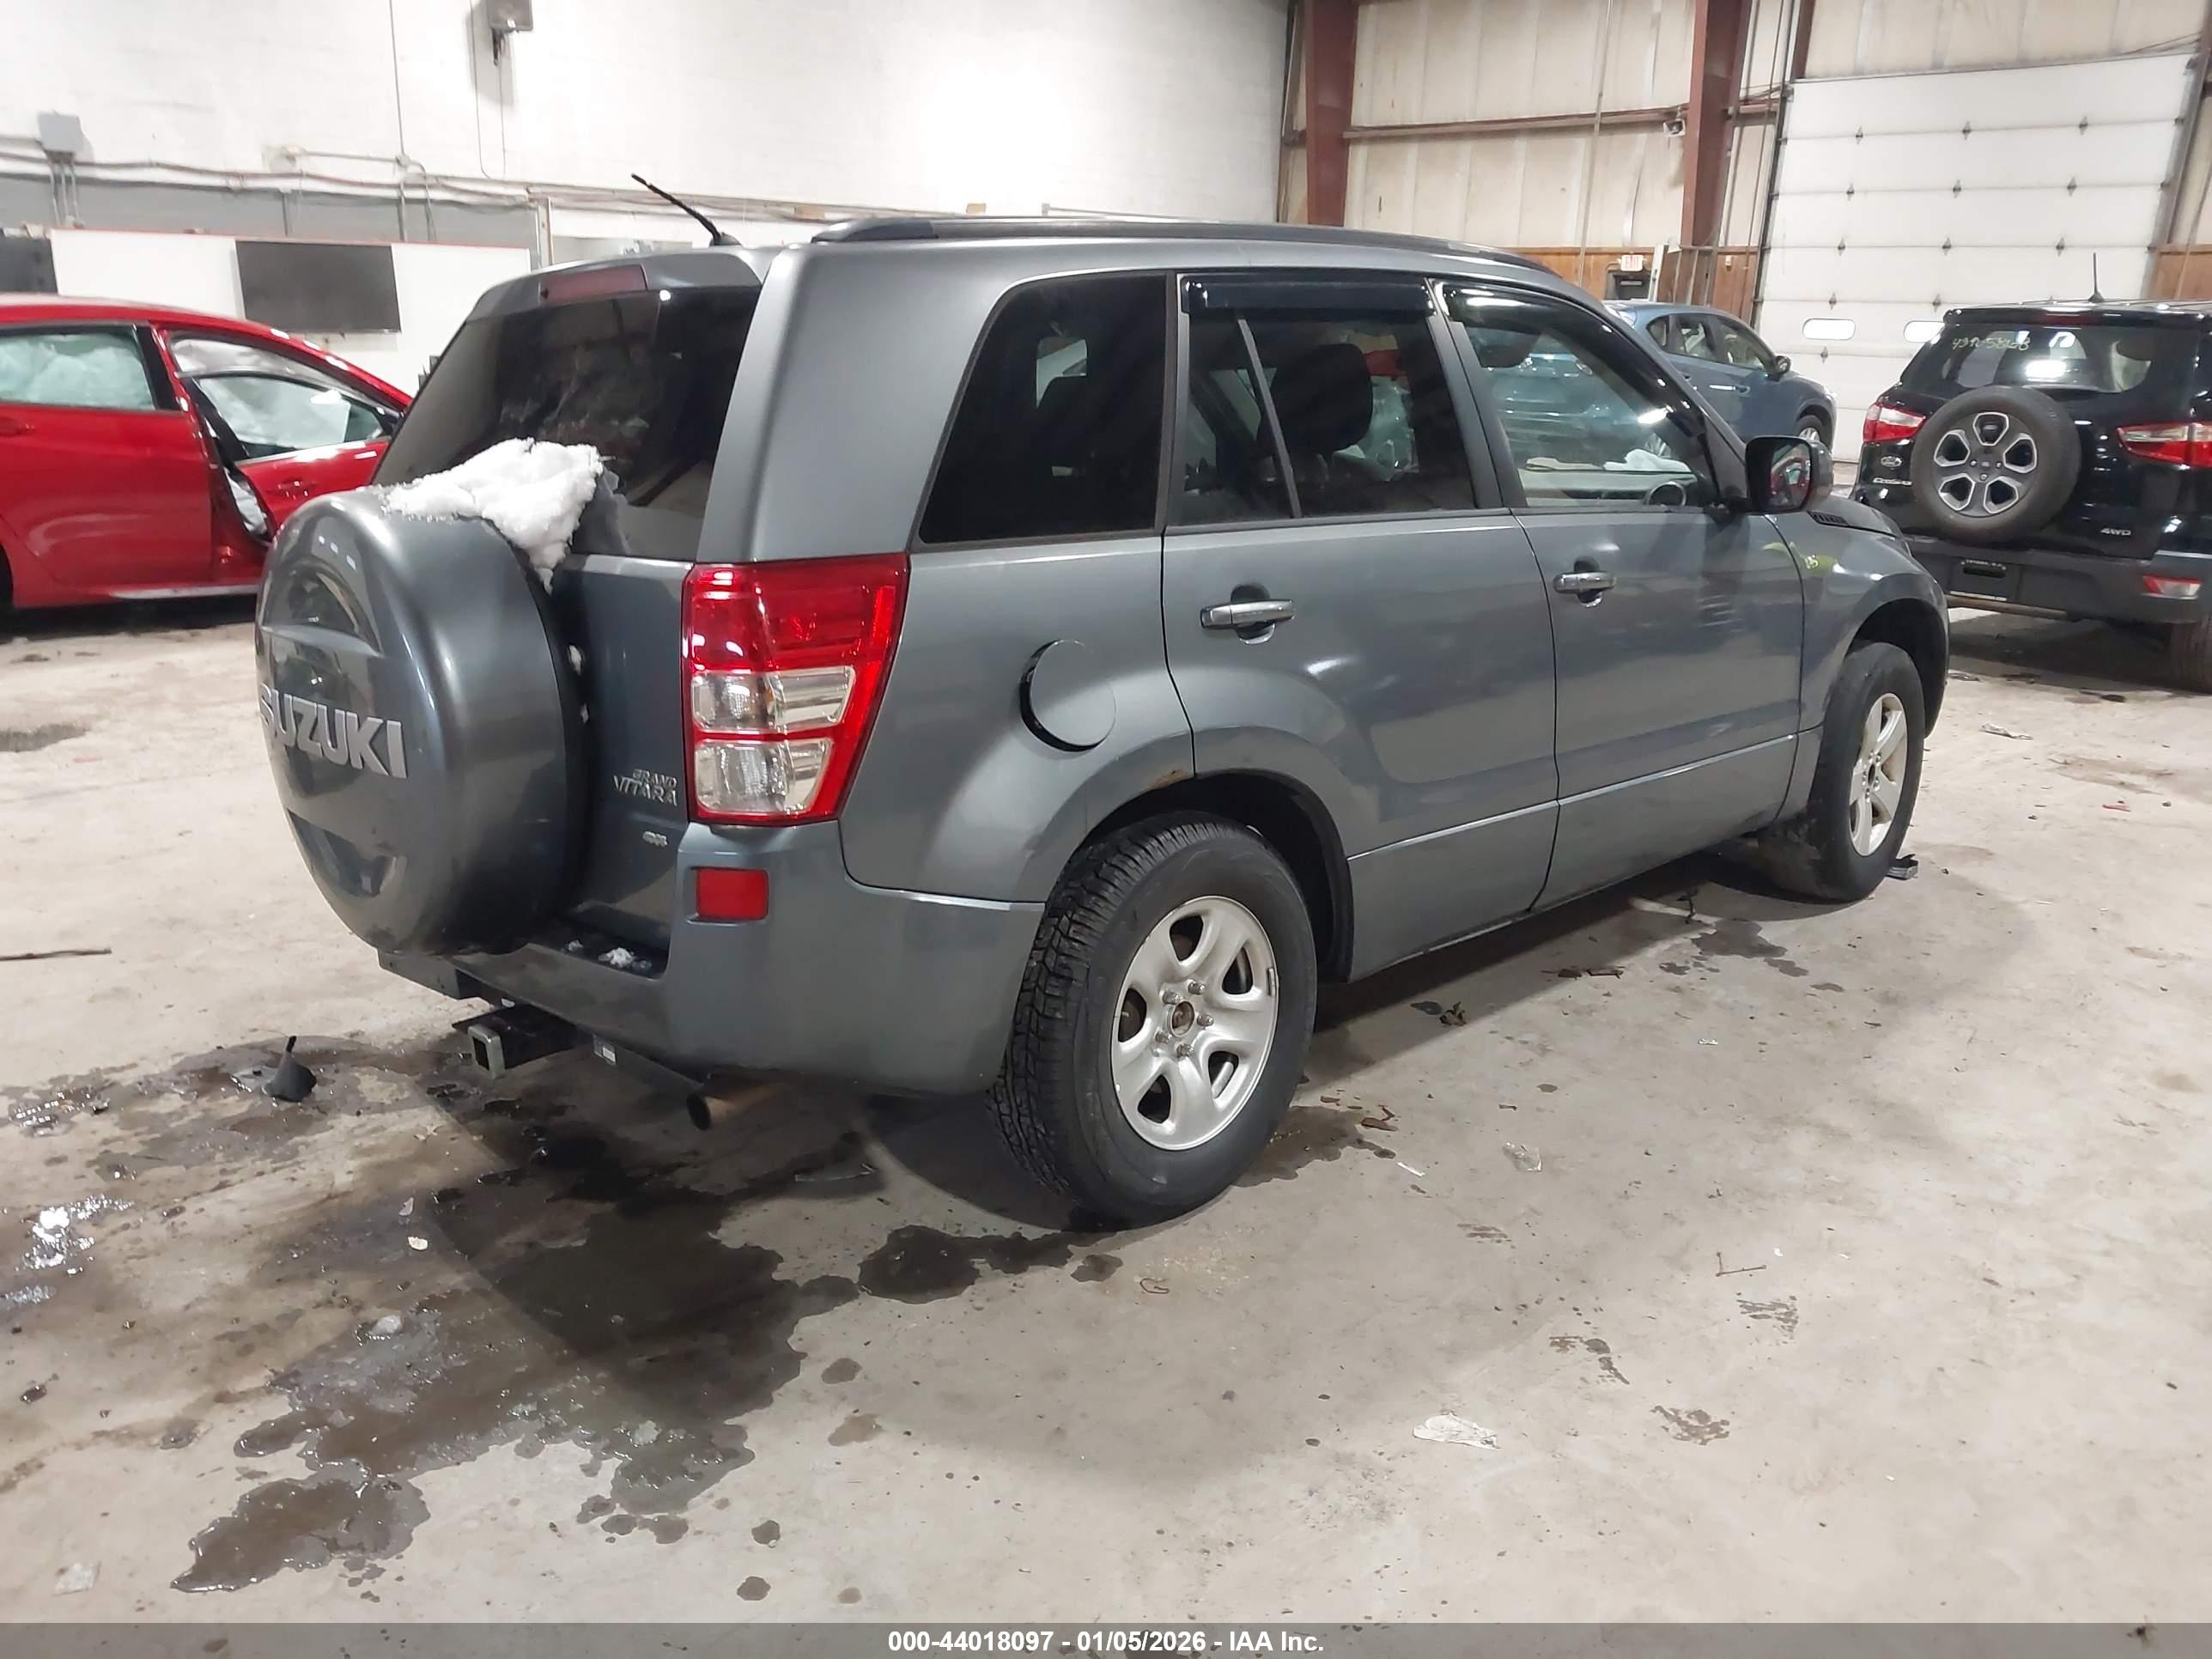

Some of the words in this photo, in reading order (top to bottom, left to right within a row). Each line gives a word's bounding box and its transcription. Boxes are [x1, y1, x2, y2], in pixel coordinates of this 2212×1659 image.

[260, 682, 407, 779] SUZUKI
[613, 775, 678, 807] VITARA
[633, 769, 678, 787] GRAND
